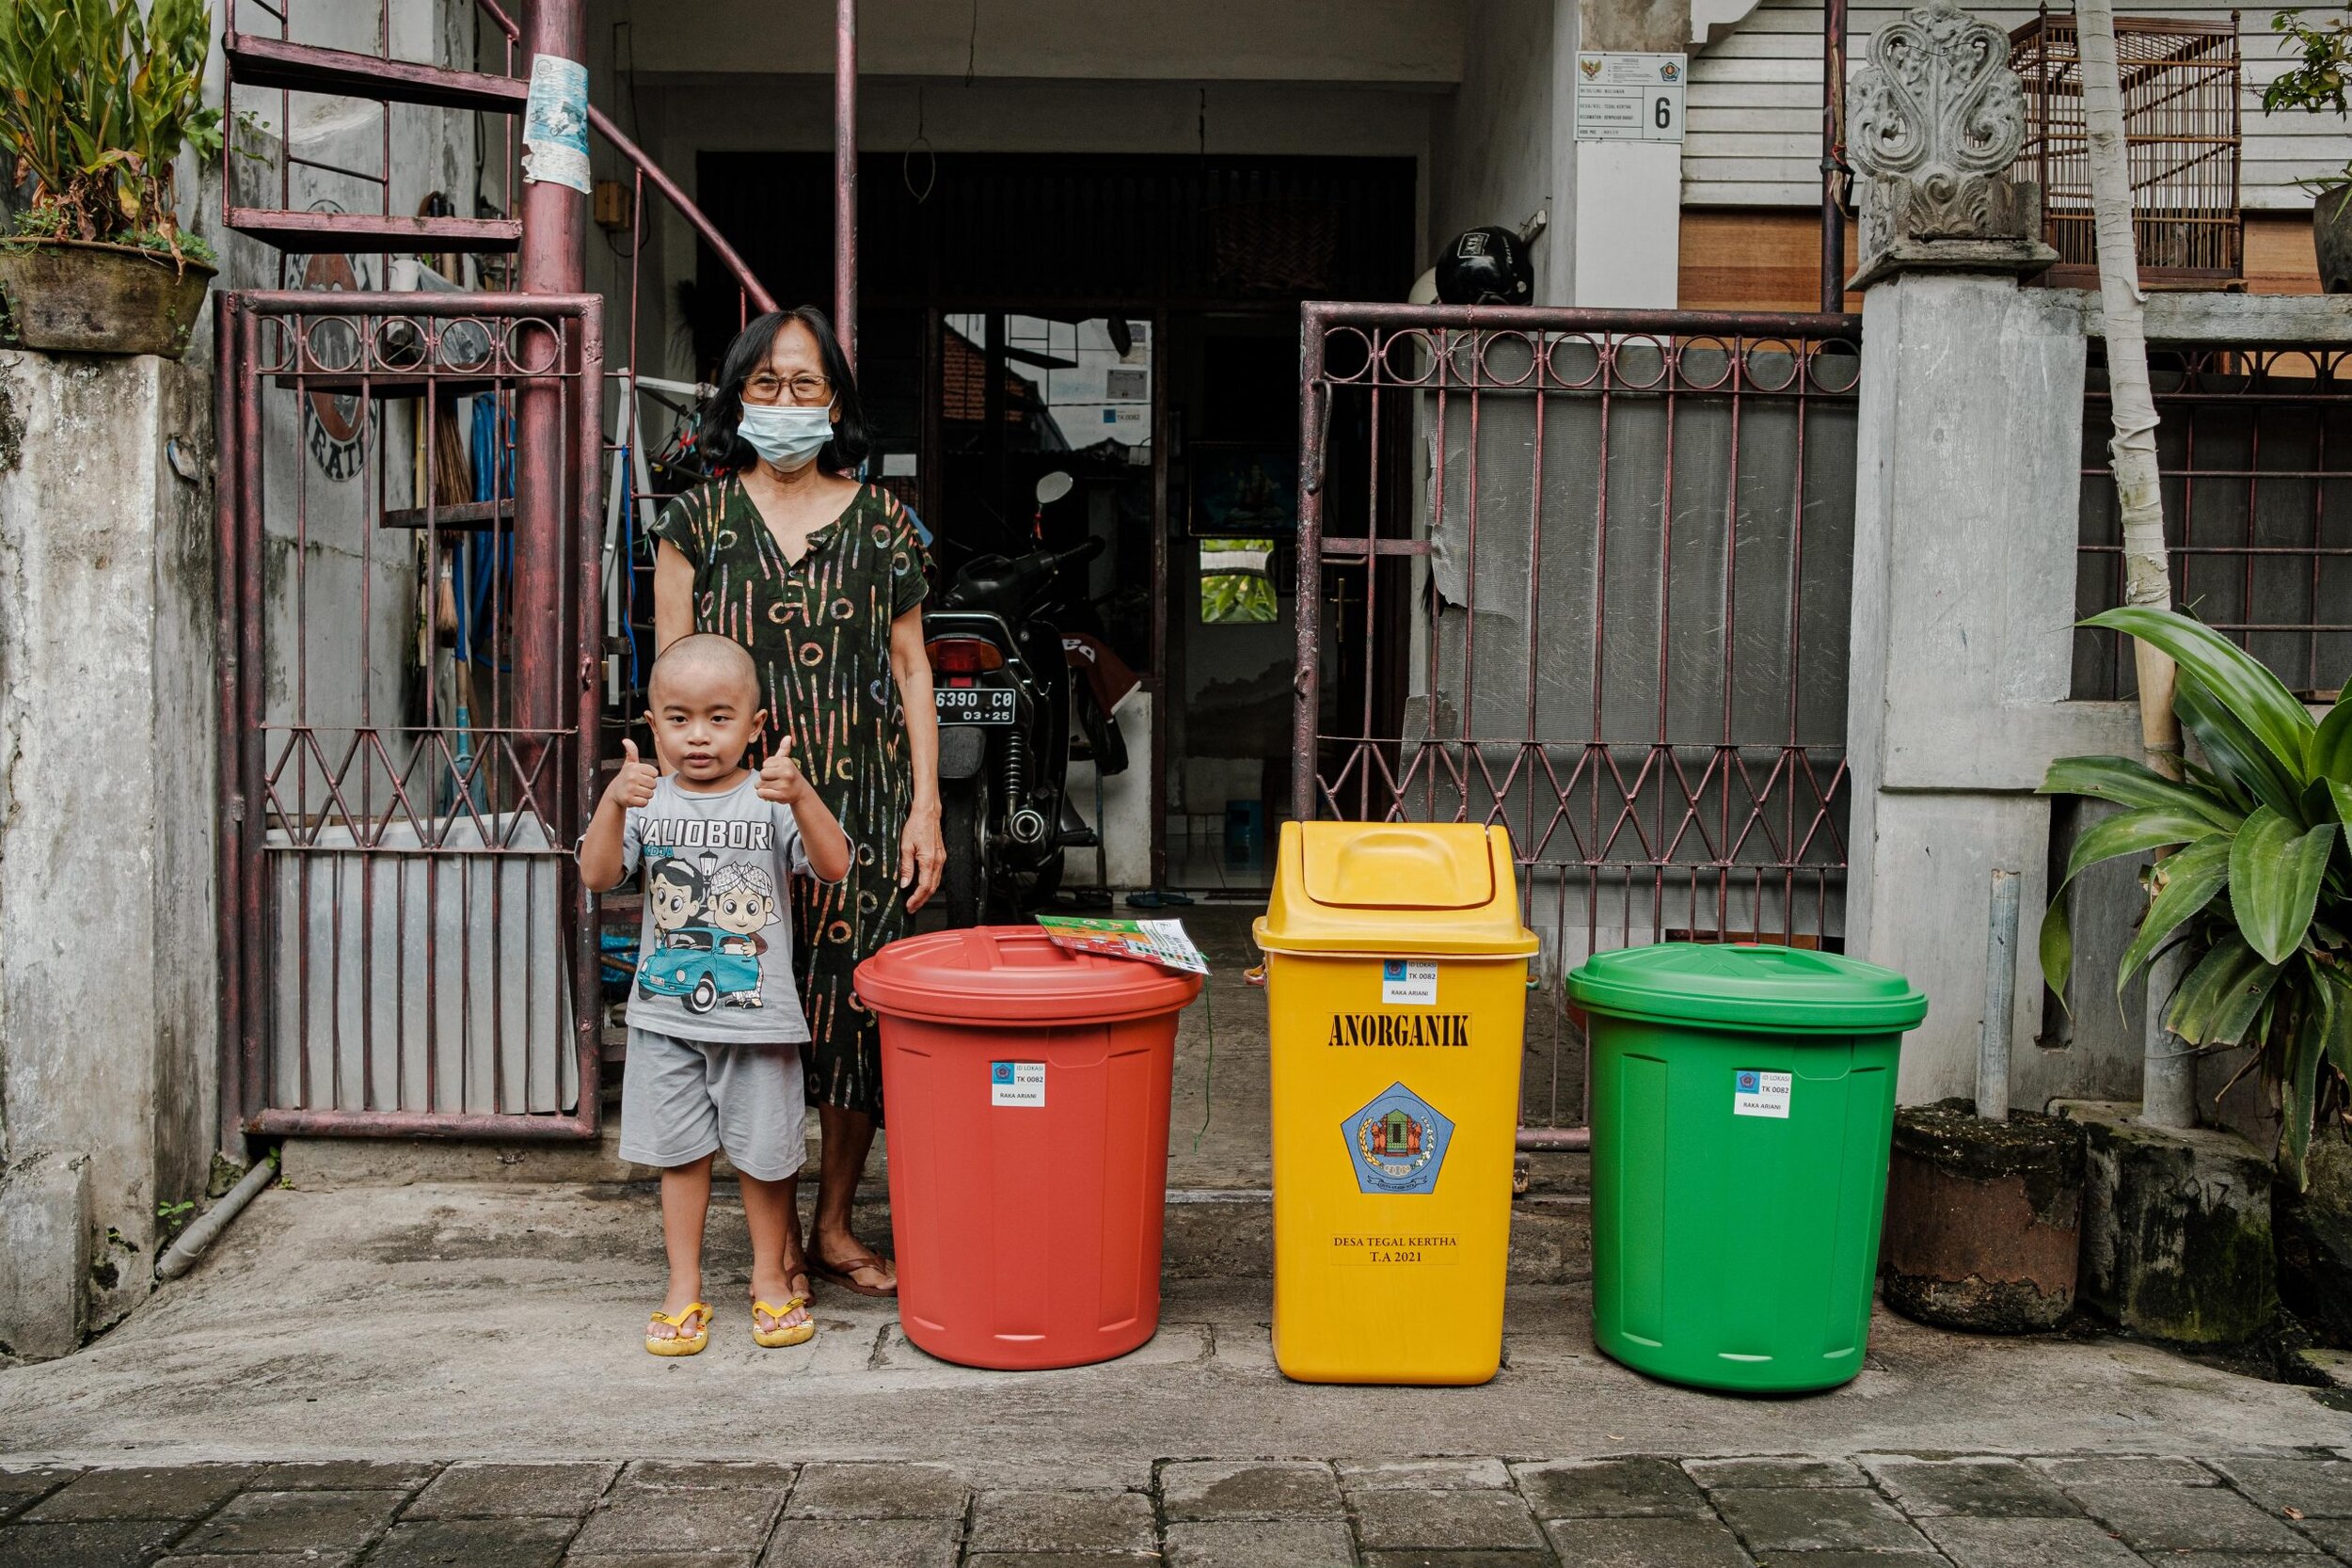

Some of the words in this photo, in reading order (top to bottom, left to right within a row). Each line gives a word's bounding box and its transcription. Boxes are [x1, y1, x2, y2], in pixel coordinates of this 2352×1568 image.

[1655, 97, 1671, 130] 6
[935, 691, 977, 706] 6390
[1328, 1014, 1469, 1047] ANORGANIK
[1333, 1237, 1363, 1246] DESA
[1367, 1237, 1406, 1246] TEGAL
[1408, 1237, 1456, 1246] KERTHA
[1370, 1251, 1392, 1262] T.A
[1394, 1251, 1422, 1262] 2021
